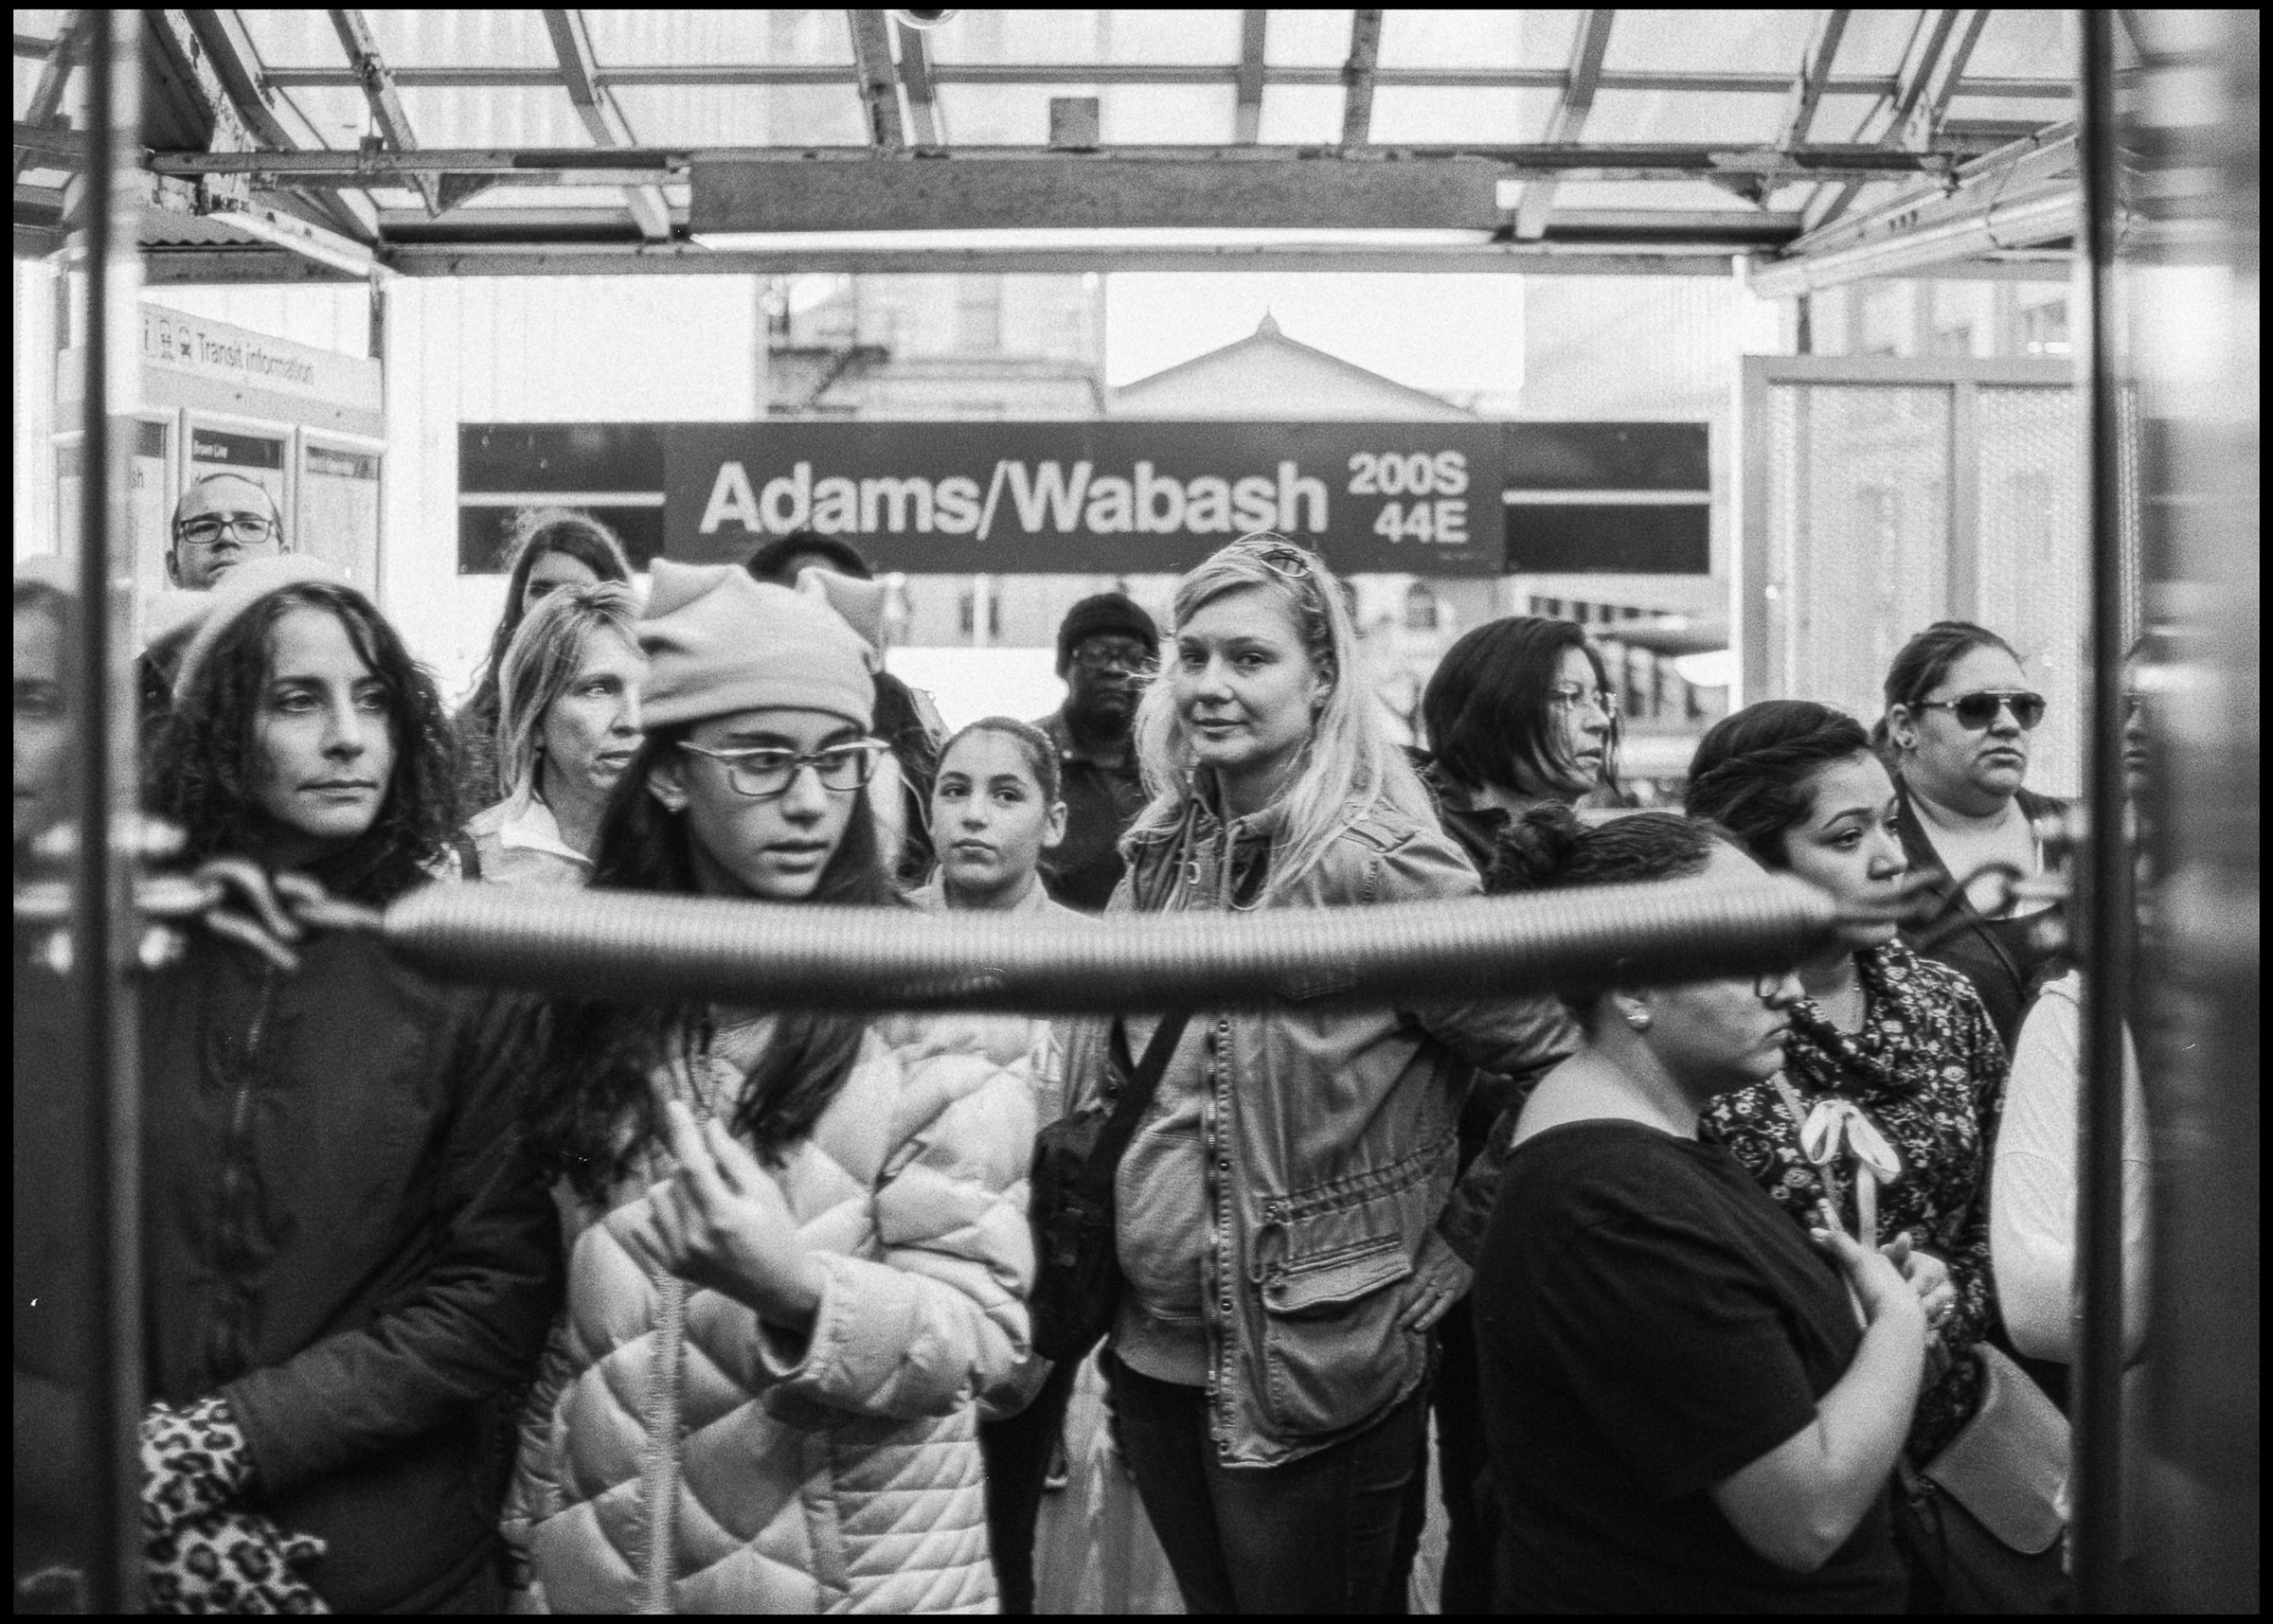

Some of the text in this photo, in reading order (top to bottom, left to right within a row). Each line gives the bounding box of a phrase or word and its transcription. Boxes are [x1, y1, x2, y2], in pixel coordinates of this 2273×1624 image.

[197, 332, 314, 384] Transit information
[1348, 450, 1469, 496] 200S
[699, 459, 1328, 541] Adams/Wabash
[1373, 499, 1468, 544] 44E
